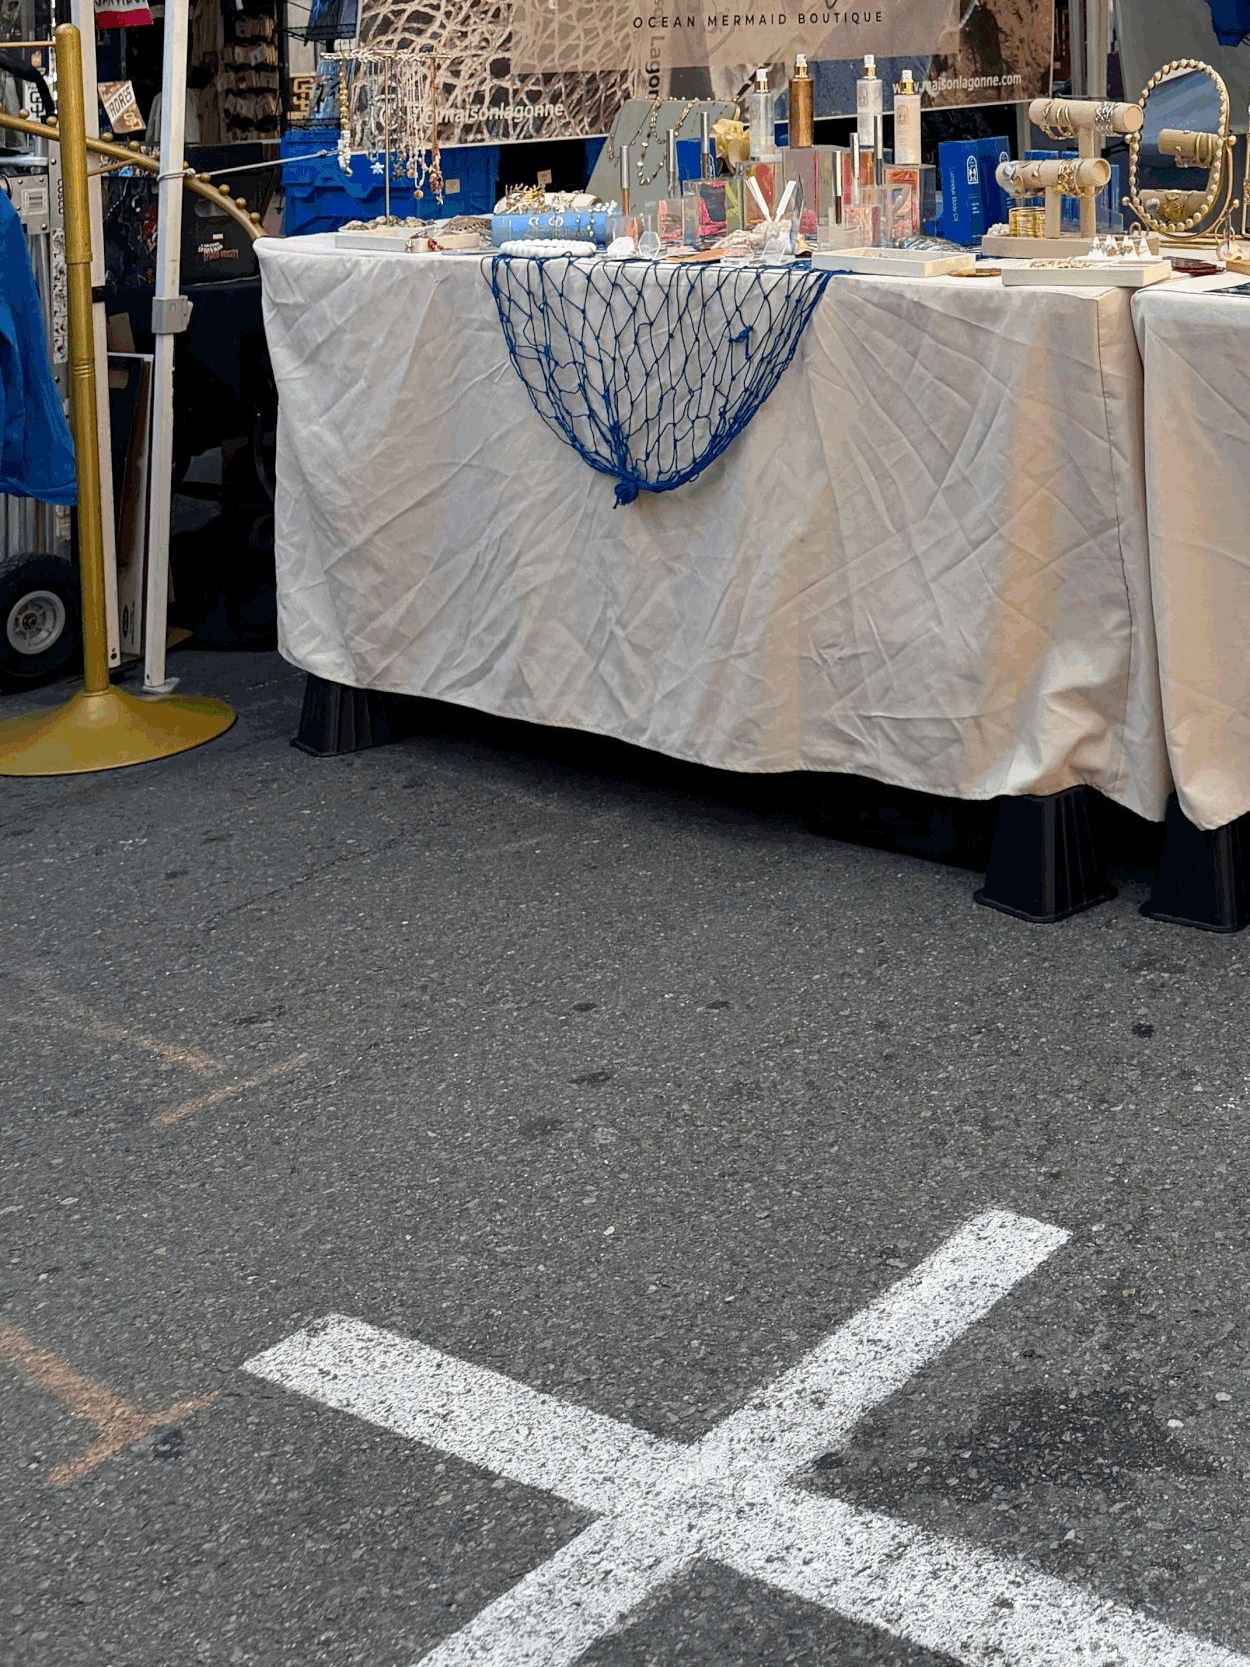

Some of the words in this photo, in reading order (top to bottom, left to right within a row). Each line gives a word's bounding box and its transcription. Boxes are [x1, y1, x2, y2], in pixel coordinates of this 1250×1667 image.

[633, 15, 696, 29] OCEAN
[707, 13, 787, 27] MERMAID
[798, 11, 883, 26] BOUTIQUE
[892, 73, 1022, 98] ww.maisonlagonne.com
